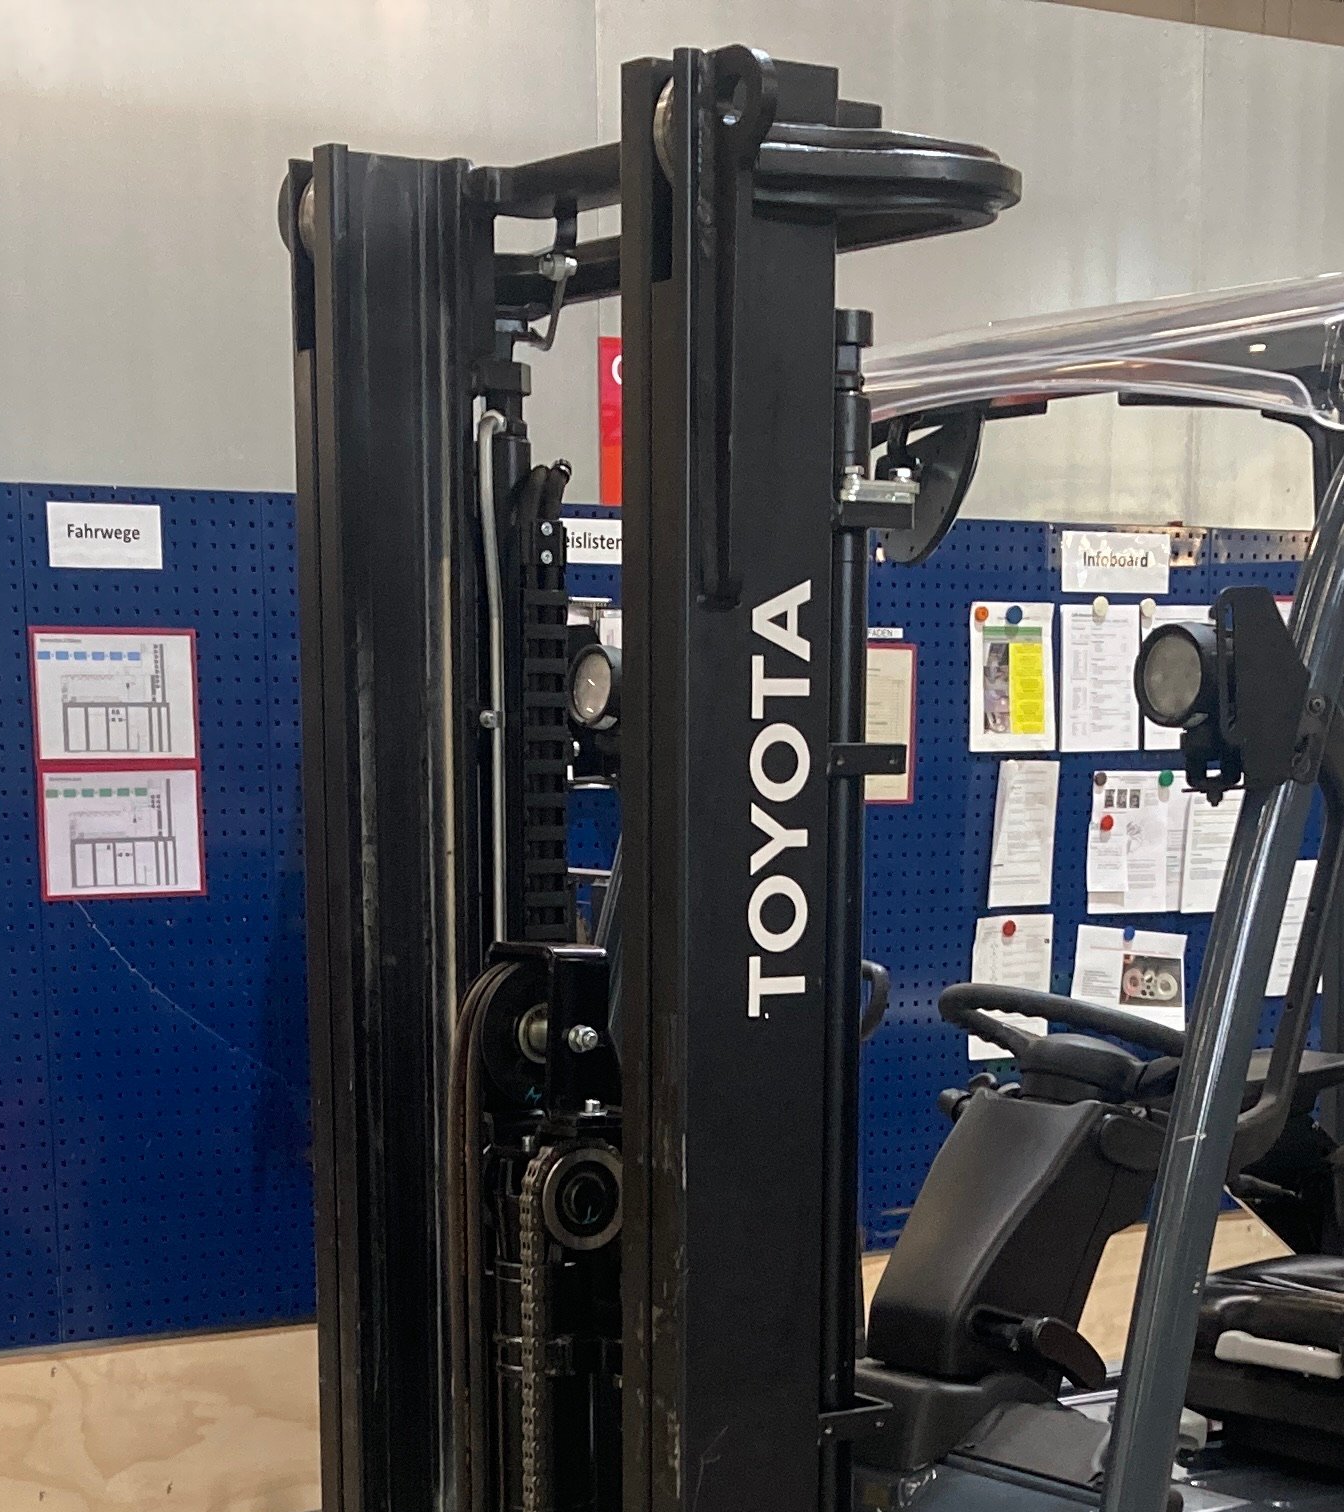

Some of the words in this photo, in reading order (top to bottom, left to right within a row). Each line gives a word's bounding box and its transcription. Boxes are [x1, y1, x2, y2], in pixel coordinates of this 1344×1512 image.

[67, 523, 141, 543] Fahrwege
[1083, 551, 1149, 568] Infoboard
[747, 579, 812, 1018] TOYOTA
